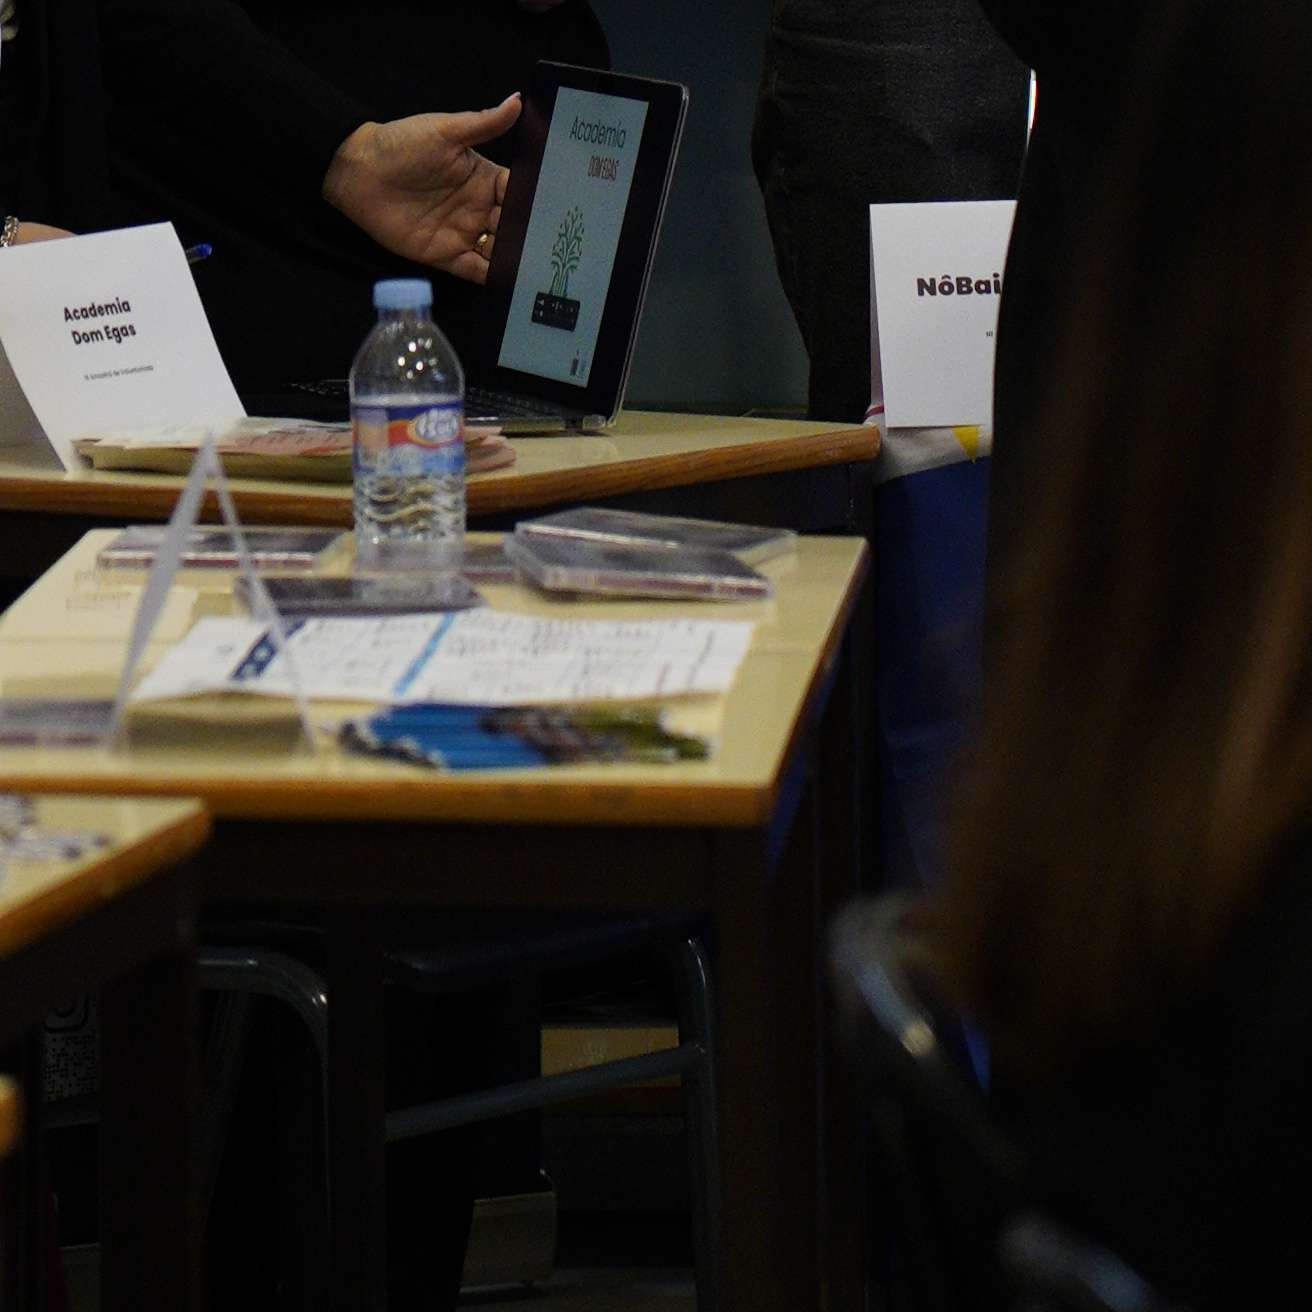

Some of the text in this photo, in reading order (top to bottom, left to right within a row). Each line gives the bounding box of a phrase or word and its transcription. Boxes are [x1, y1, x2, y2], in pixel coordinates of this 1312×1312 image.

[917, 273, 1001, 296] NôBai
[63, 297, 131, 323] Academia
[71, 324, 136, 345] Dom Egas
